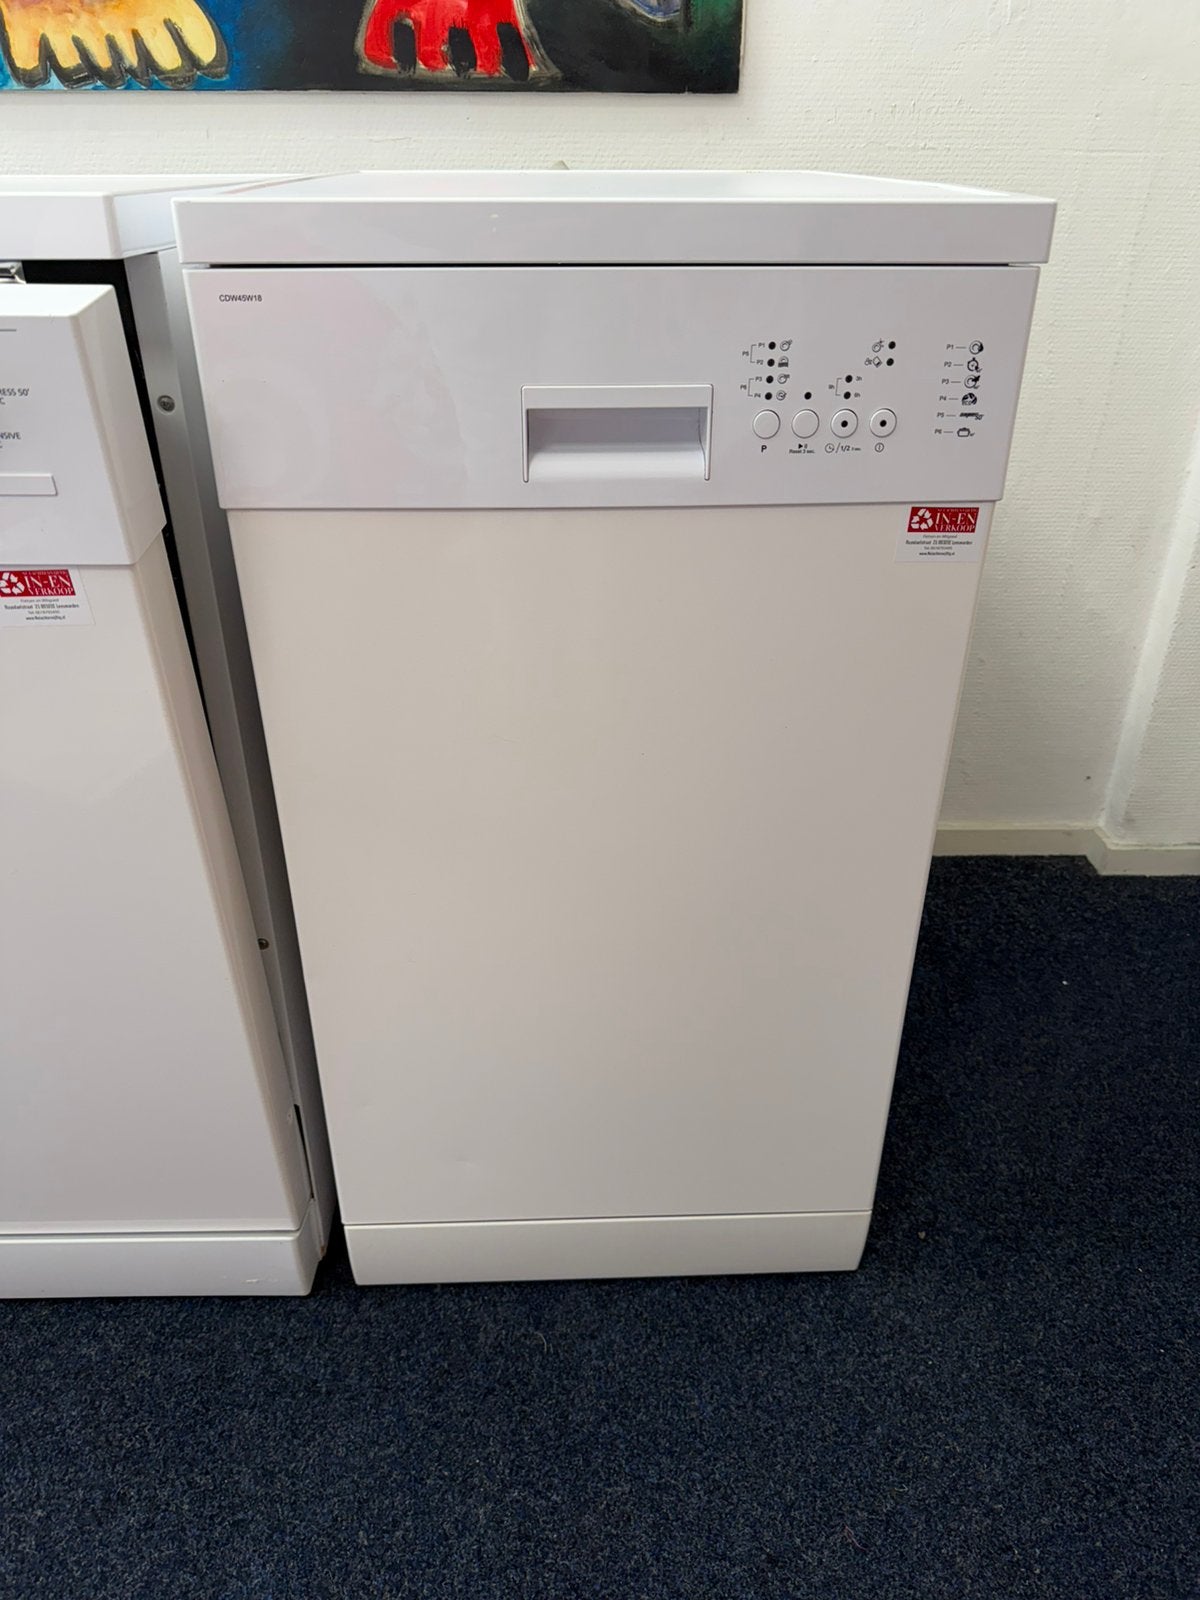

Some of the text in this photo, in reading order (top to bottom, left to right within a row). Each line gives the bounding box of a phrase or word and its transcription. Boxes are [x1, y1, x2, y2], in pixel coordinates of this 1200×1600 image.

[219, 294, 263, 302] CDW45W18
[935, 513, 977, 524] IN-EN
[935, 524, 976, 532] VERKOOP
[24, 575, 71, 588] IN-EN
[28, 587, 74, 595] VERKOOP
